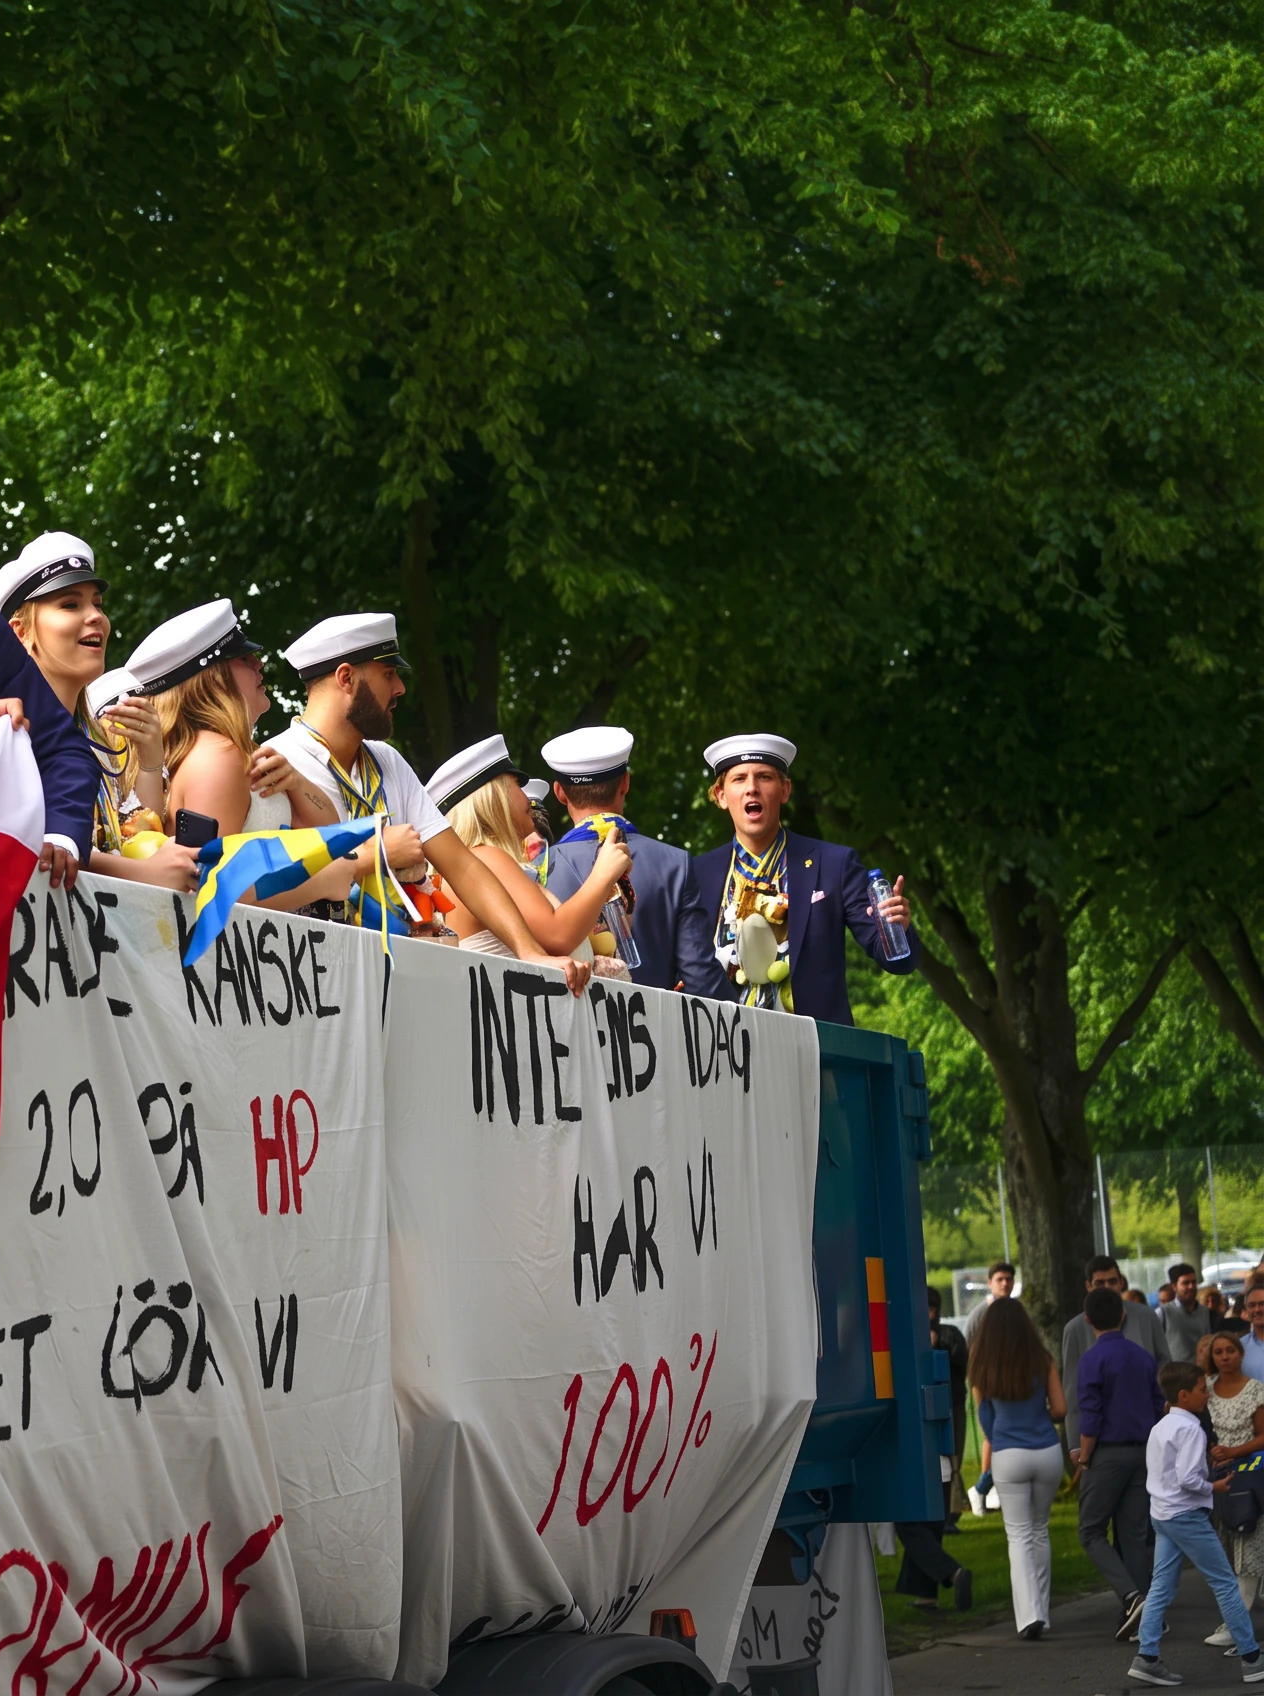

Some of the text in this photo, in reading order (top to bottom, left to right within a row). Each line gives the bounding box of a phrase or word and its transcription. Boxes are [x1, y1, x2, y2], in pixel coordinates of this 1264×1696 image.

[173, 892, 341, 1026] KANSKE
[469, 963, 582, 1127] INTE
[680, 995, 750, 1093] IDAG
[28, 1078, 102, 1218] 2,0
[250, 1089, 319, 1215] HP
[573, 1137, 718, 1307] HAR VI
[255, 1294, 299, 1393] VI
[537, 1329, 718, 1537] 100%
